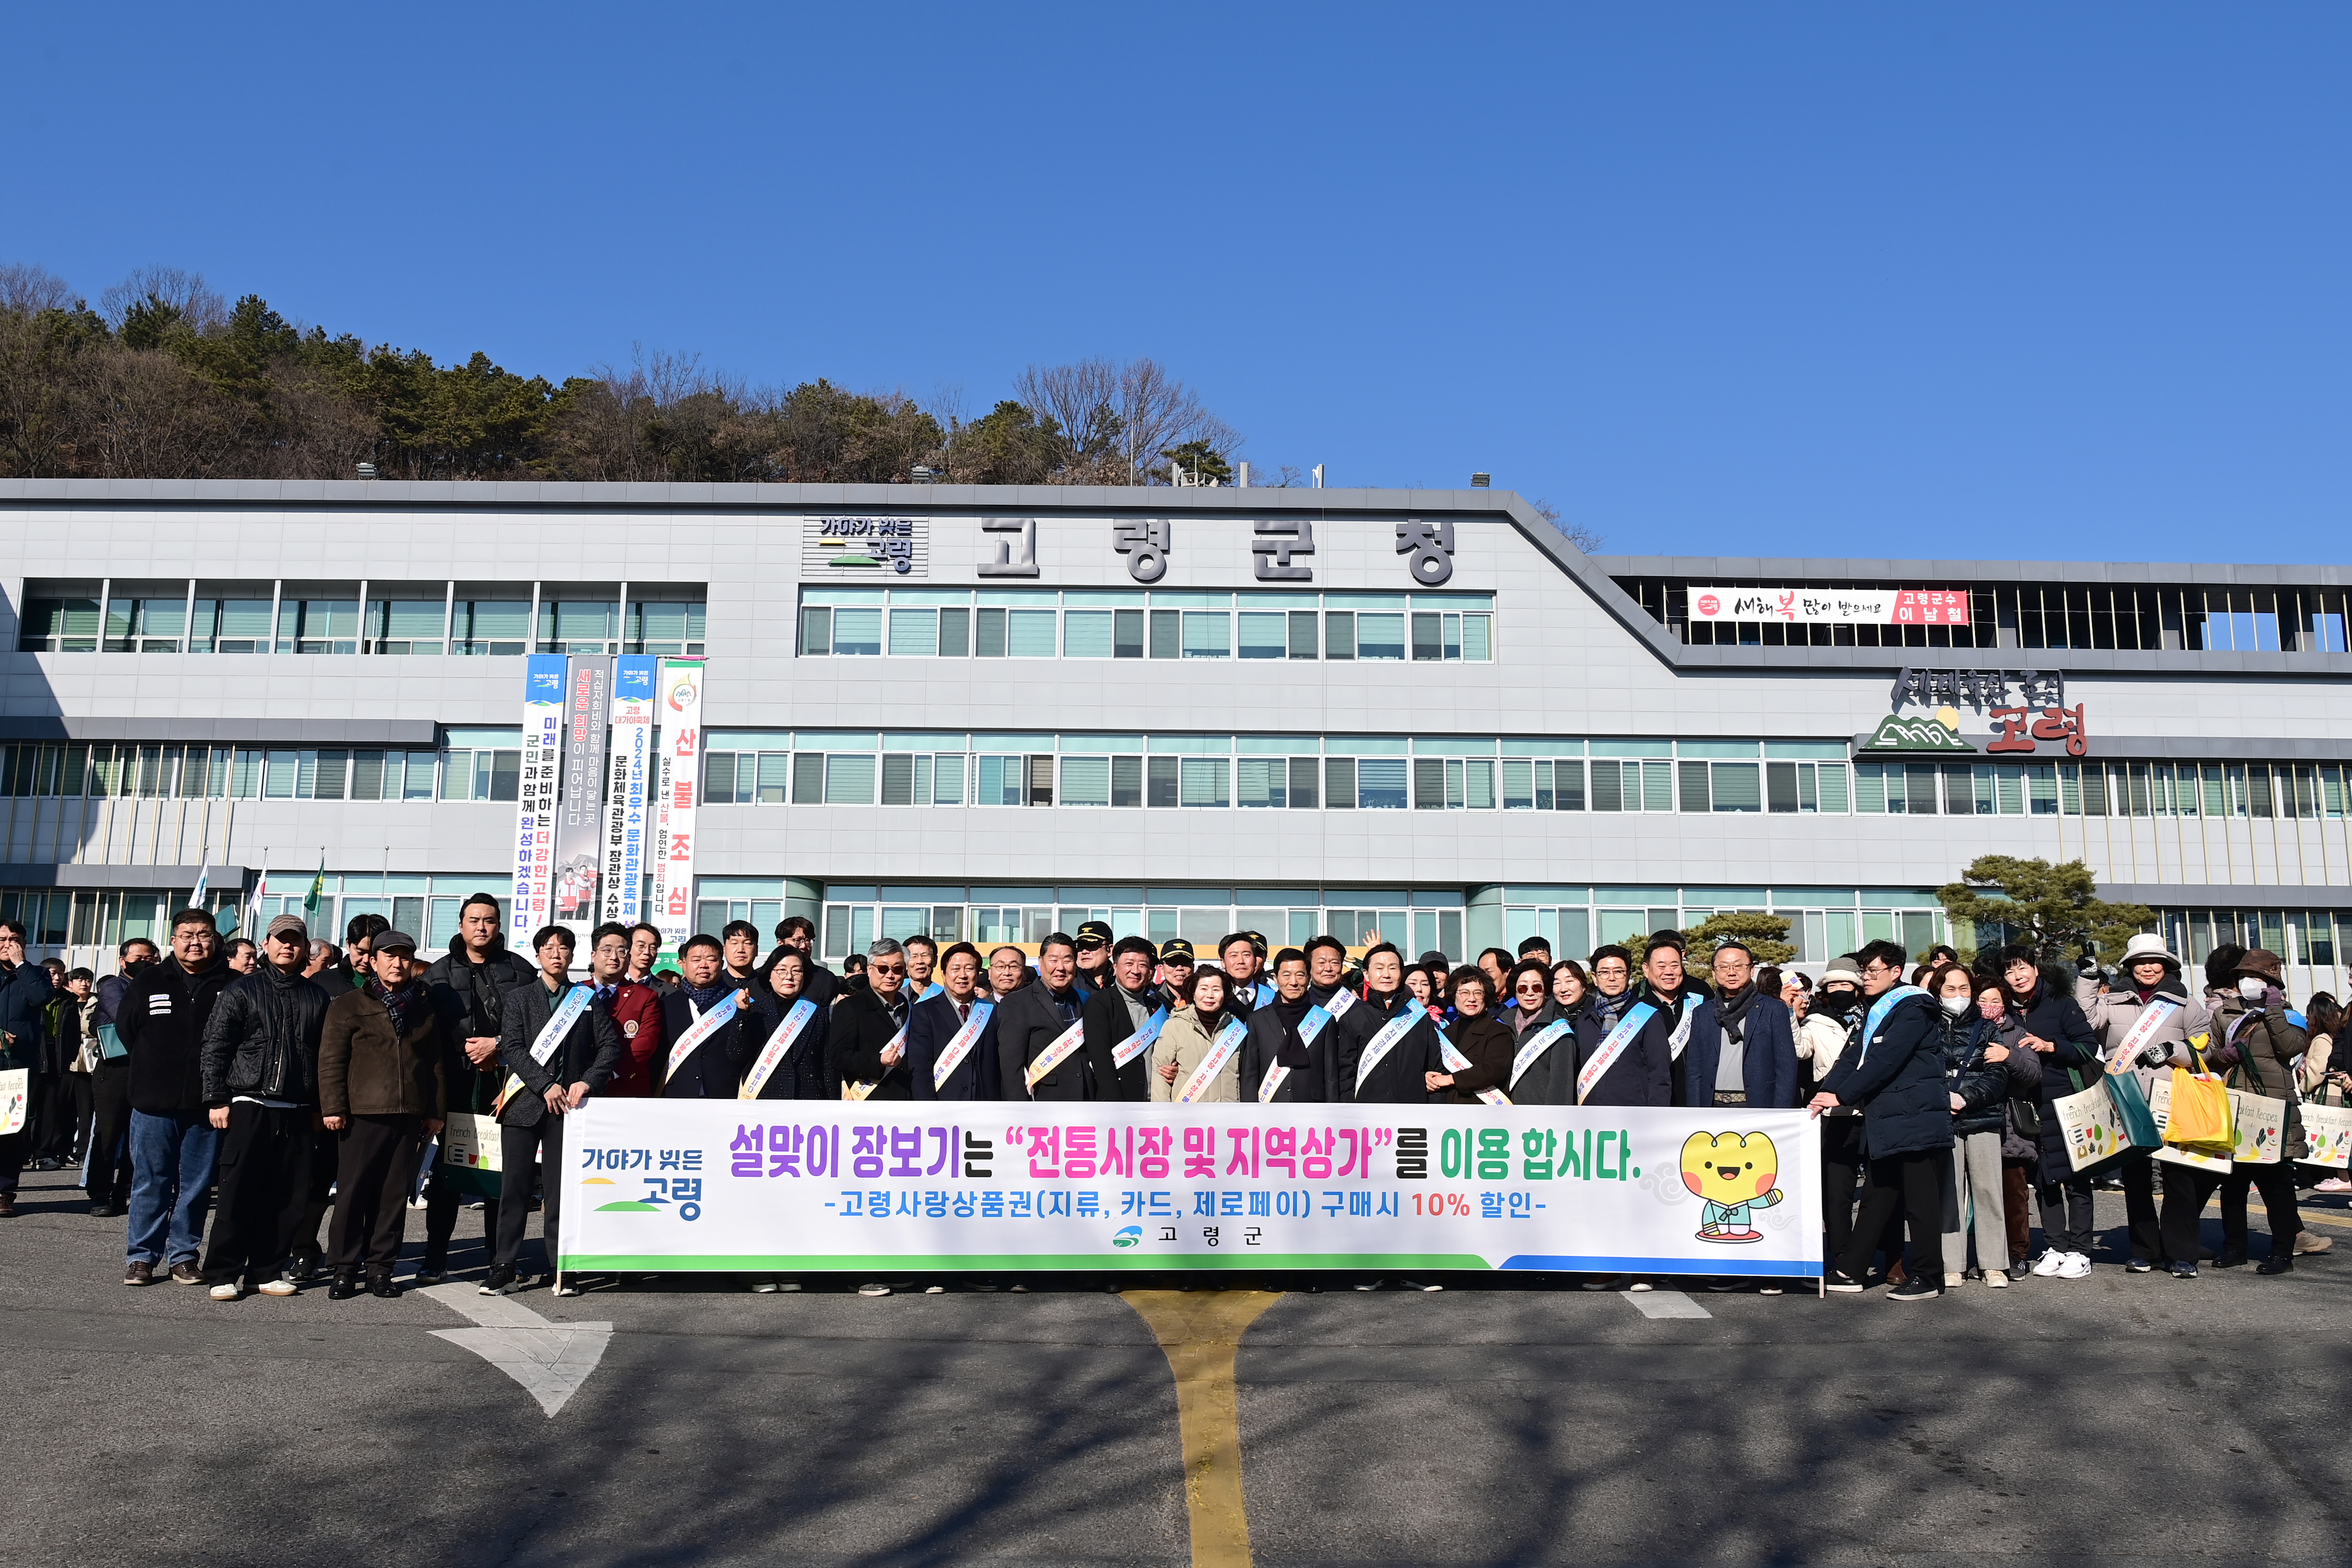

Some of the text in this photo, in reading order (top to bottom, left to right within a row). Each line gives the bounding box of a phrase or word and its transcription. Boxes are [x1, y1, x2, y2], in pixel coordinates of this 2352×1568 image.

[820, 517, 912, 535] 가야가 빚은
[866, 538, 912, 573] 고령
[1735, 590, 1882, 621] 새해 복 많이 받으세요
[1903, 592, 1956, 605] 고령군수
[545, 679, 559, 689] 고령
[635, 676, 649, 686] 고령
[1891, 667, 2011, 701] 세계유산
[590, 670, 604, 731] 적십자회비와
[626, 706, 640, 715] 고령
[615, 716, 650, 724] 대가야축제
[1986, 702, 2087, 757] 고령
[542, 717, 557, 762] 미래를
[568, 669, 591, 826] 새로운 희망이 피어납니다
[589, 734, 601, 754] 함께
[524, 735, 540, 779] 군민과
[587, 757, 599, 788] 마음이
[522, 784, 537, 812] 함께
[538, 765, 554, 827] 준비하는
[606, 755, 627, 919] 문화체육관광부 장관상 수상
[655, 757, 671, 916] 실수로 낸 산불, 엄연한 범죄입니다.
[622, 829, 640, 915] 문화관광축제
[670, 936, 686, 946] 고령
[541, 992, 585, 1048] 장보기는 전통시장
[690, 1016, 716, 1040] 지역경제
[777, 1021, 797, 1045] 지역경제
[1301, 1020, 1316, 1038] 활기찬
[1616, 1022, 1634, 1041] 활기찬
[2139, 1009, 2161, 1033] 전통시장
[957, 1023, 978, 1048] 지역경제
[1371, 1027, 1397, 1055] 지역경제
[1514, 1023, 1568, 1072] 장보기는 전통시장
[1117, 1039, 1142, 1059] 지역경제
[1596, 1040, 1619, 1066] 지역경제
[1181, 1026, 1241, 1103] 장보기는 전통시장 지역상가에
[1260, 1067, 1281, 1103] 함께 만듭시
[2062, 1106, 2082, 1121] French
[2083, 1095, 2102, 1114] Breakfast
[2155, 1091, 2172, 1106] Frenc
[2238, 1103, 2278, 1123] akfast Recipes
[2316, 1114, 2337, 1125] Breakfast
[450, 1125, 500, 1142] French Breakfast
[582, 1149, 703, 1171] 가야가 빚은
[729, 1123, 840, 1178] 설맞이
[851, 1124, 994, 1179] 장보기는
[1182, 1126, 1217, 1179] 및
[1439, 1127, 1510, 1180] 이용
[1521, 1127, 1641, 1181] 합시다.
[642, 1177, 702, 1221] 고령
[1121, 1190, 1182, 1219] 카드,
[1192, 1189, 1311, 1219] 제로페이)
[1321, 1190, 1399, 1219] 구매시
[1412, 1193, 1471, 1217] 10%
[1157, 1225, 1263, 1247] 고령군
